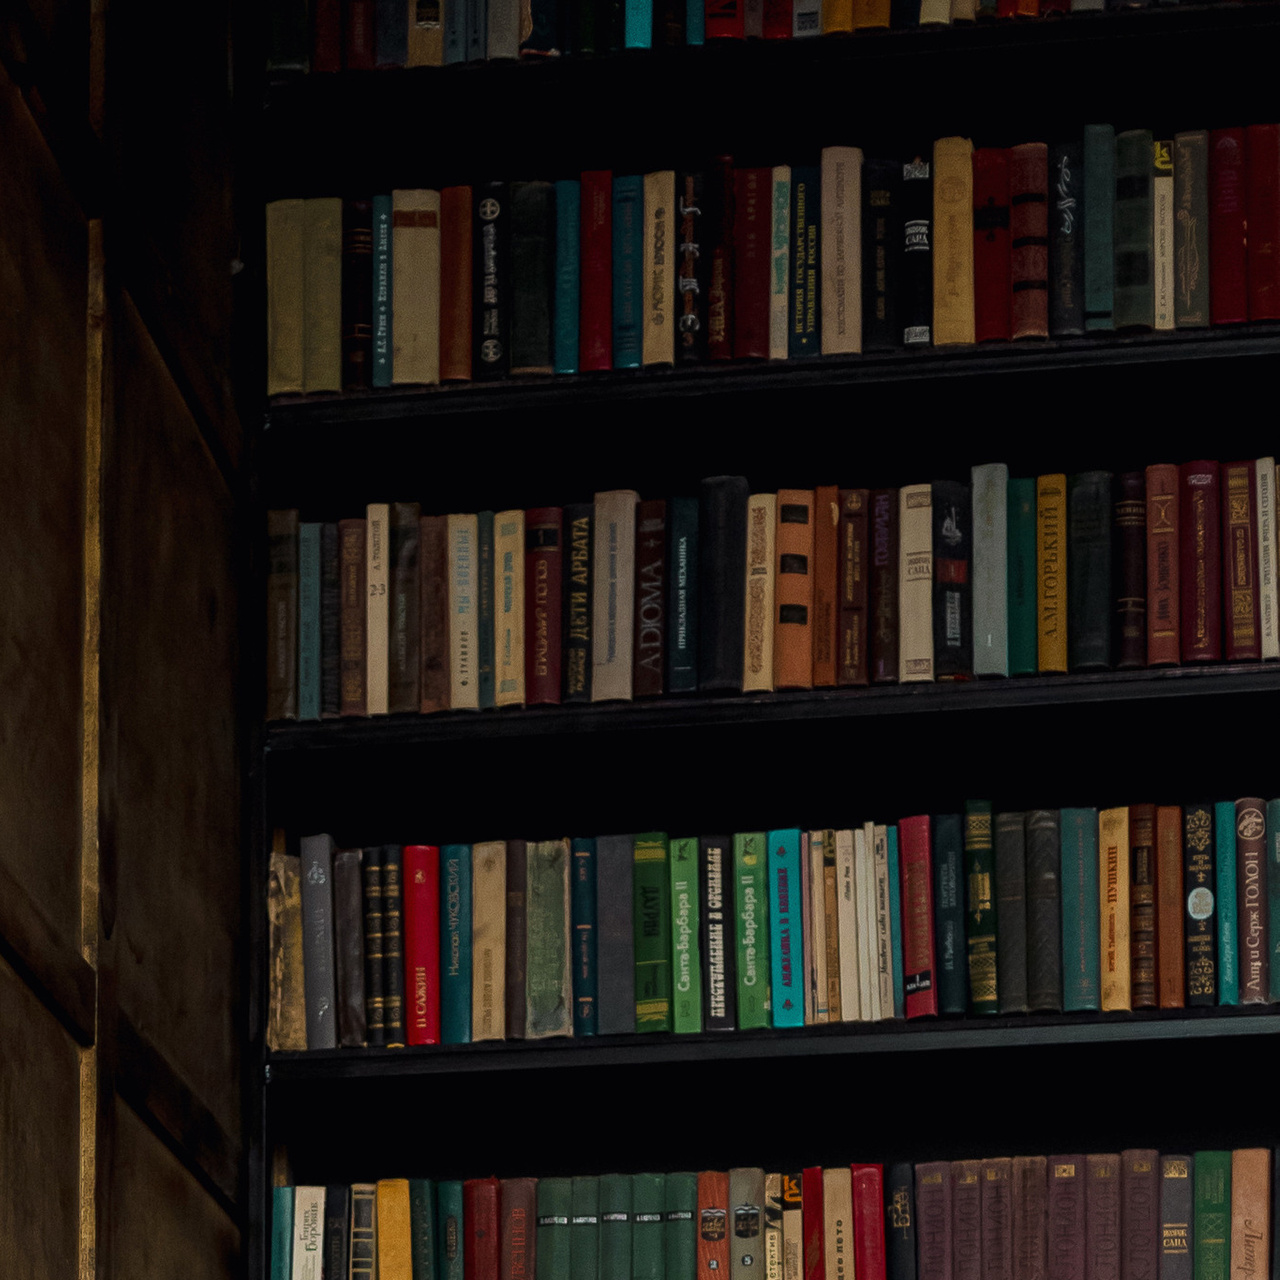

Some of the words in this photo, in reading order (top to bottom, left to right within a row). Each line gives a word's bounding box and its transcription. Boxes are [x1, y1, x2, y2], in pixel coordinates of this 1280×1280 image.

[796, 183, 806, 284] ГОСУДАРСТВЕННОГО
[807, 225, 817, 264] РОССИИ
[795, 289, 804, 334] ИСТОРИЯ
[807, 269, 816, 333] УПРАВЛЕНИЯ
[571, 516, 590, 585] АРБАТА
[677, 536, 688, 587] МЕХАНИКА
[1040, 506, 1059, 638] А.М.ГОРЬКИЙ
[570, 592, 590, 640] ДЕТИ
[677, 589, 687, 649] ПРИКЛАДНАЯ
[446, 859, 461, 930] ЧУКОВСКИЙ
[707, 847, 723, 908] ОРСИВАЛЕ
[777, 867, 789, 913] КВЕБЕКЕ
[1107, 845, 1118, 903] ПУШКИН
[1244, 850, 1260, 908] ГОЛОН
[677, 893, 692, 992] Санта-Барбара
[742, 887, 758, 986] Санта-Барбара
[780, 928, 792, 987] АНЖЕЛИКА
[1247, 910, 1265, 948] Серж
[415, 967, 428, 1015] САЖИН
[708, 924, 726, 1017] ПРЕСТУПЛЕНИЕ
[299, 1209, 310, 1241] Генрих
[305, 1202, 319, 1252] Боровик
